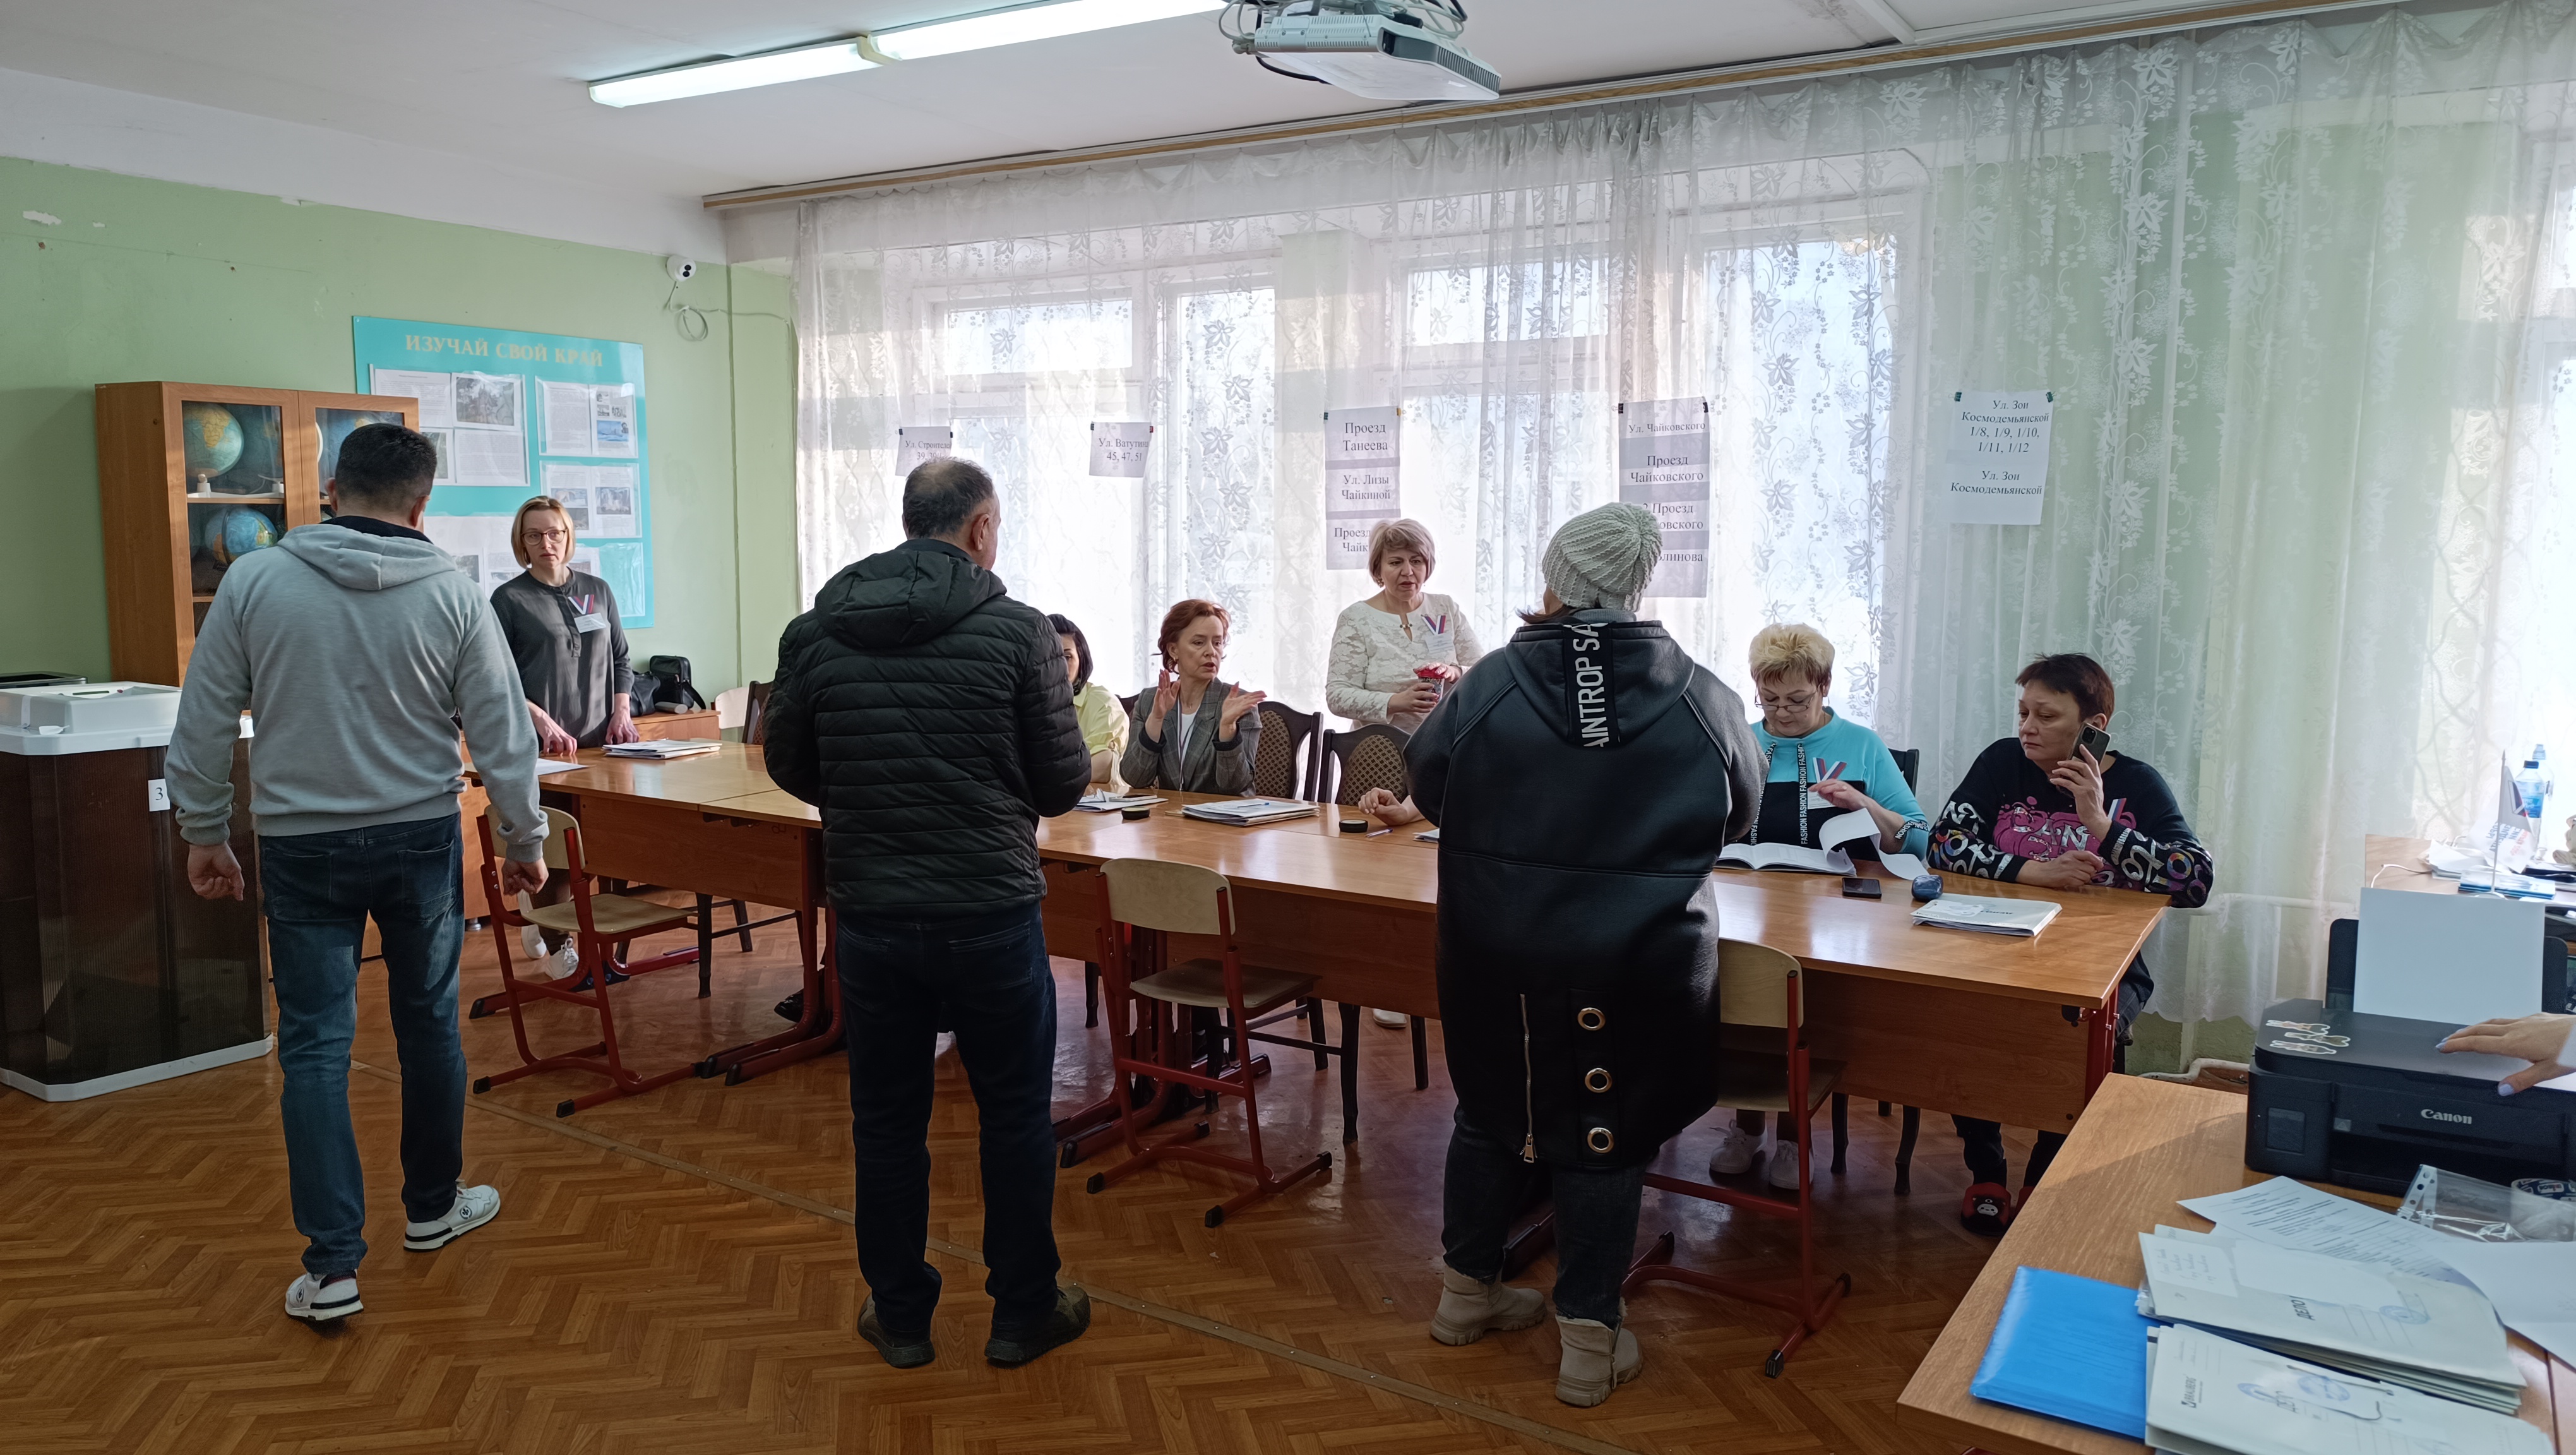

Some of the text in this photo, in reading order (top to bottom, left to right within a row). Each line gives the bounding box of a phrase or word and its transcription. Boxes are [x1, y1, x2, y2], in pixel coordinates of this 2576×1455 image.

[405, 335, 602, 366] ИЗУЧАЙ СВОЙ КРАЙ
[1993, 400, 2029, 409] Ул. Зои
[1961, 412, 2049, 424] Космодемьянской
[1345, 422, 1386, 436] Проезд
[1629, 423, 1705, 433] Ул. Чайковского
[1971, 426, 2039, 439] 1/8, 1/9, 1/10,
[1099, 438, 1113, 447] Ул.
[1343, 440, 1388, 451] Танеева
[1978, 442, 2029, 454] 1/11, 1/12
[1106, 452, 1142, 462] 45, 47, 51
[1647, 455, 1688, 468] Проезд
[1343, 475, 1389, 484] Ул. Лизы
[1631, 472, 1703, 482] Чайковского
[1982, 470, 2020, 481] Ул. Зои
[1950, 482, 2042, 494] Космодемьянской
[1342, 489, 1390, 500] Чайкиной
[1652, 503, 1693, 515] Проезд
[1799, 767, 1808, 791] FASHION
[155, 787, 163, 801] 3
[1800, 793, 1808, 818] FASHION
[1800, 818, 1808, 844] FASHION
[2421, 1109, 2472, 1124] Canon
[2291, 1300, 2316, 1320] ДЕЛО
